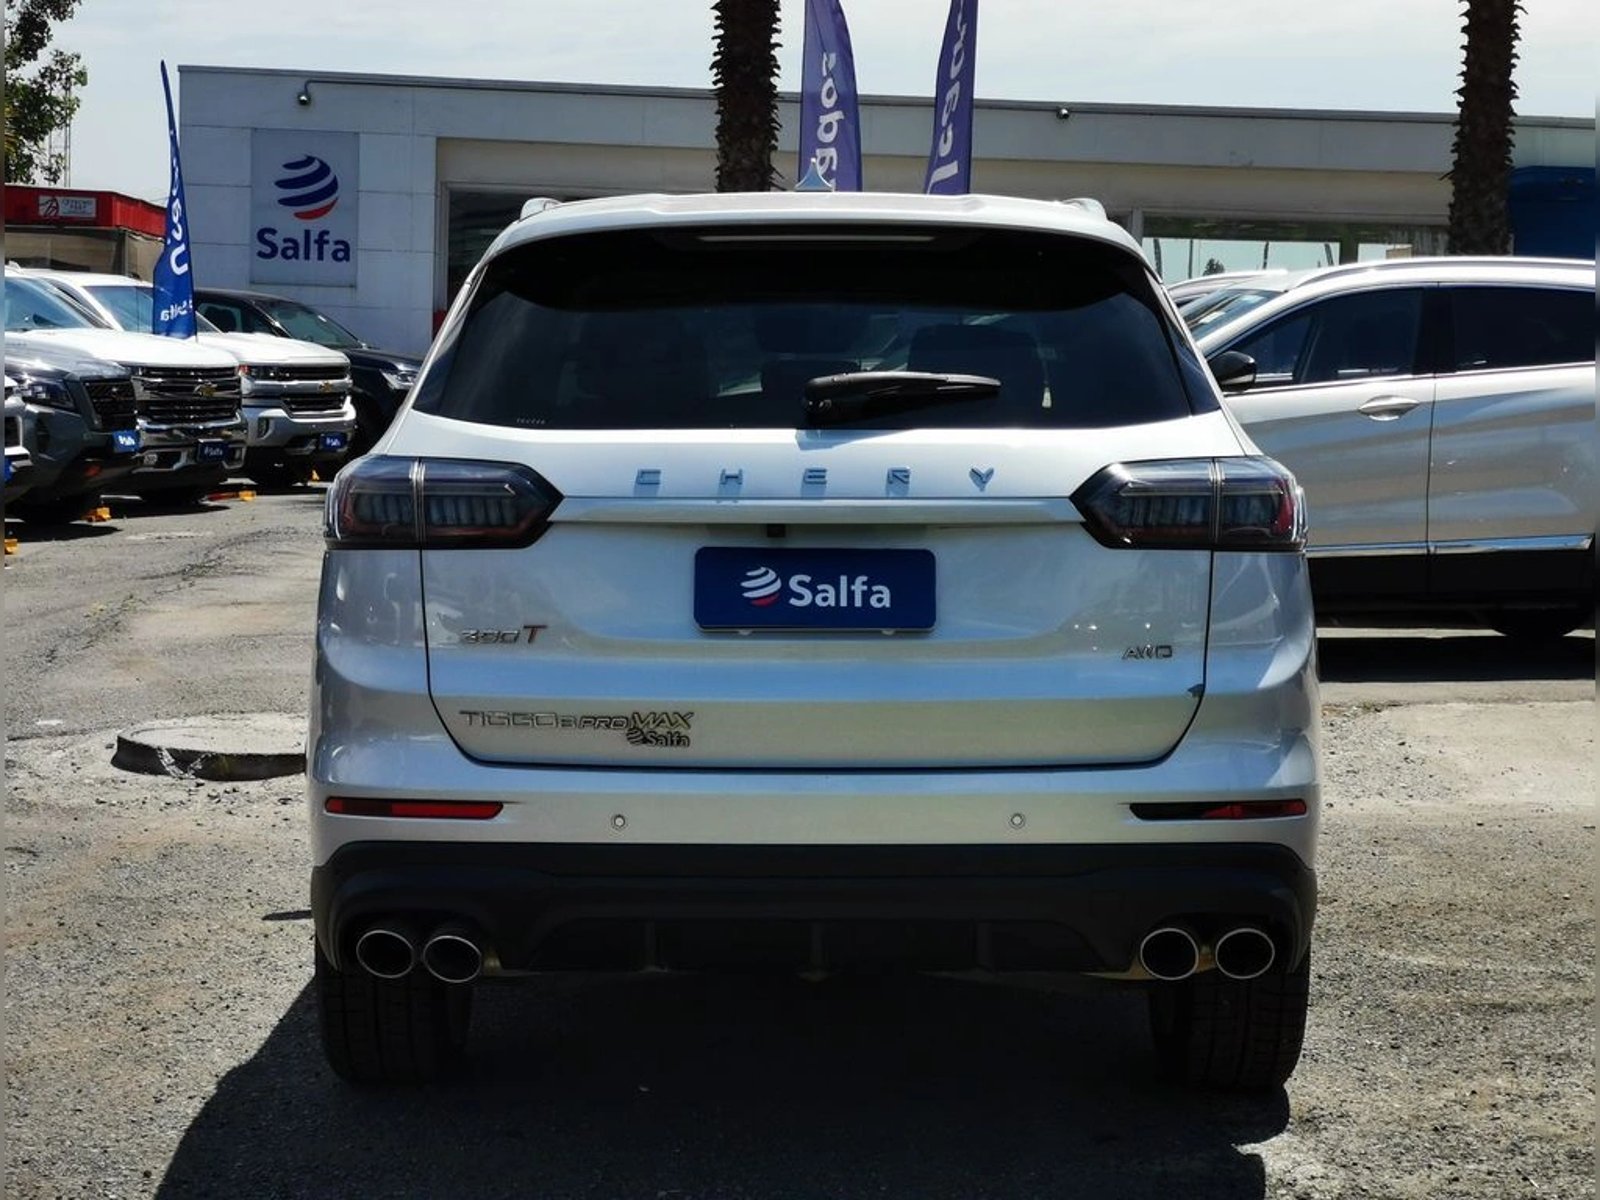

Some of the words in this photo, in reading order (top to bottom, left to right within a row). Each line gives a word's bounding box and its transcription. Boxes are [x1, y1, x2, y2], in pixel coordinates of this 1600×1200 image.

[256, 227, 351, 262] Salfa
[636, 467, 994, 491] CHERY
[789, 574, 891, 608] Salfa
[1121, 645, 1173, 660] AWD
[631, 711, 694, 730] MAX
[646, 730, 691, 748] Salfa
